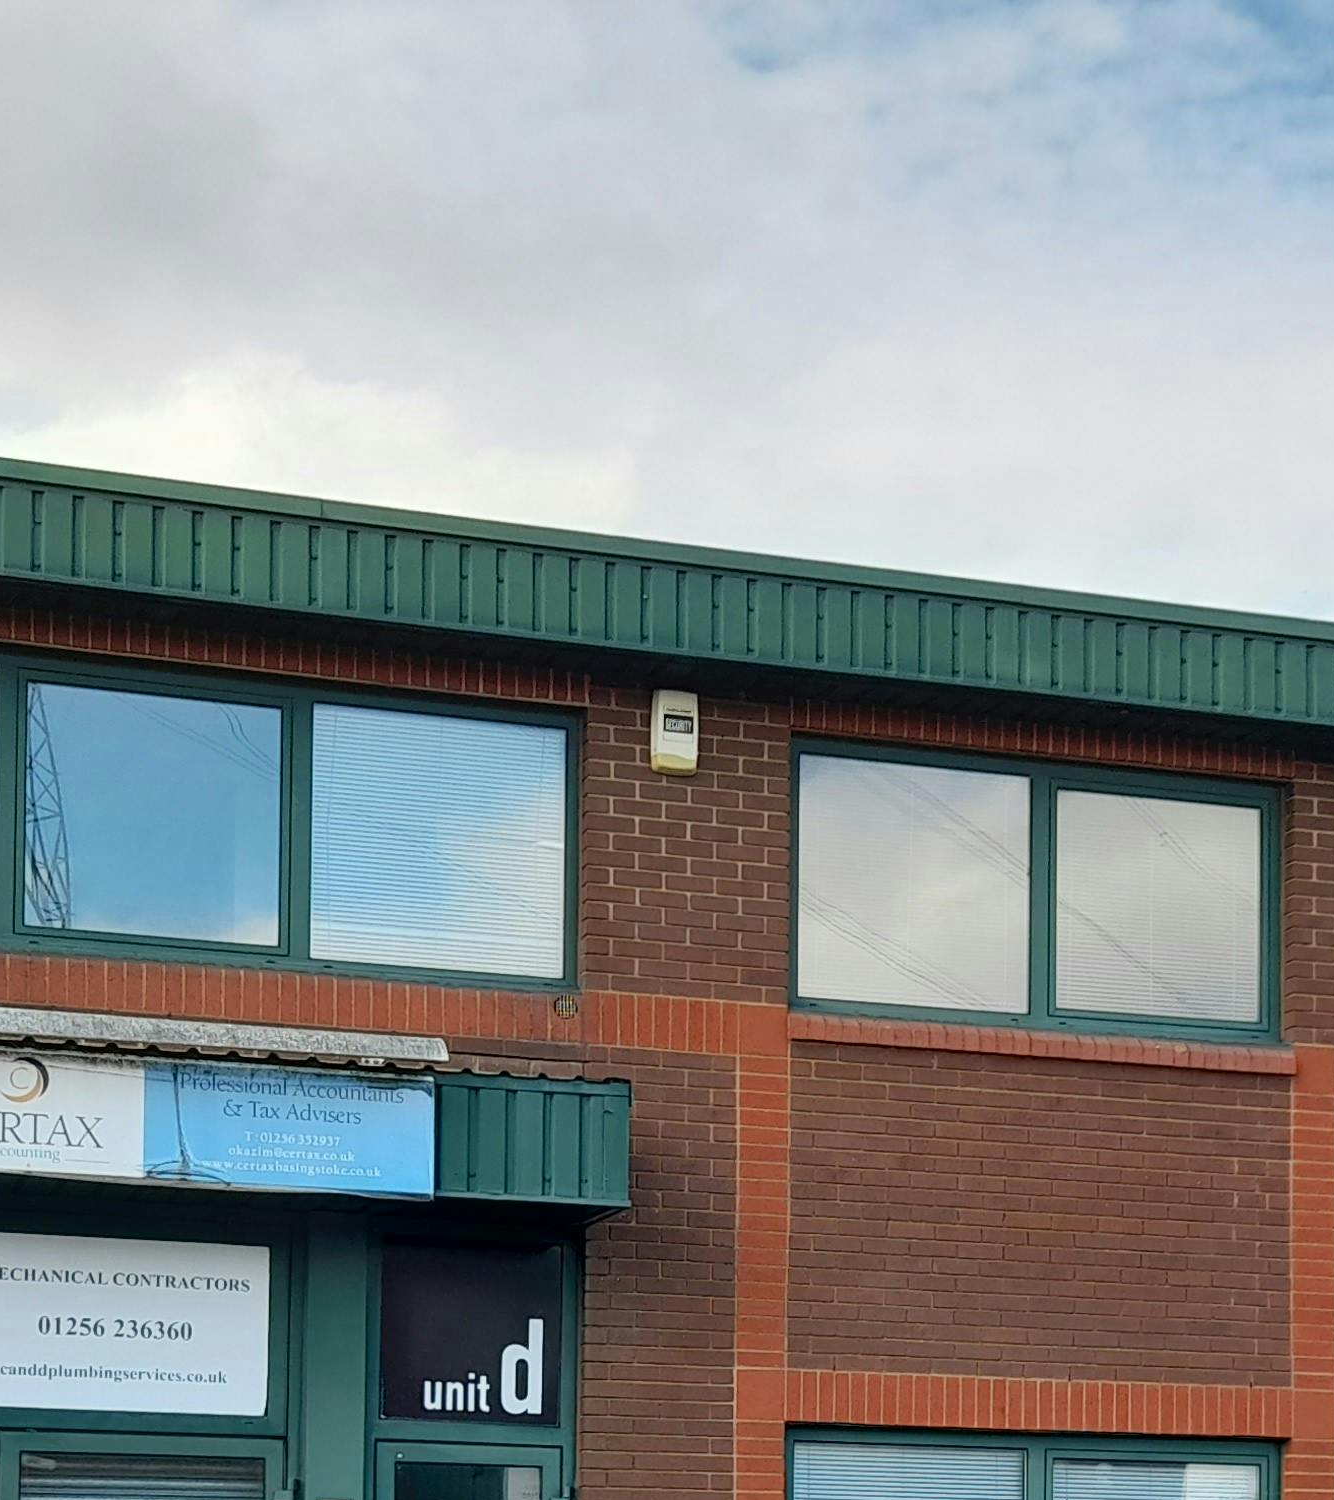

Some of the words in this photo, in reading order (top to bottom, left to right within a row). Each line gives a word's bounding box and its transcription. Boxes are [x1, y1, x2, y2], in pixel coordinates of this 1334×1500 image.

[179, 1071, 287, 1096] Professional
[292, 1078, 405, 1104] Accountants
[223, 1099, 243, 1117] &
[248, 1100, 280, 1119] Tax
[286, 1103, 362, 1125] Advisers
[113, 1272, 251, 1293] CONTRACTORS
[38, 1315, 105, 1338] 01256
[114, 1319, 193, 1341] 236360
[0, 1363, 228, 1384] canddplumbingservices.co.uk
[424, 1372, 490, 1413] unit
[501, 1318, 544, 1415] d
